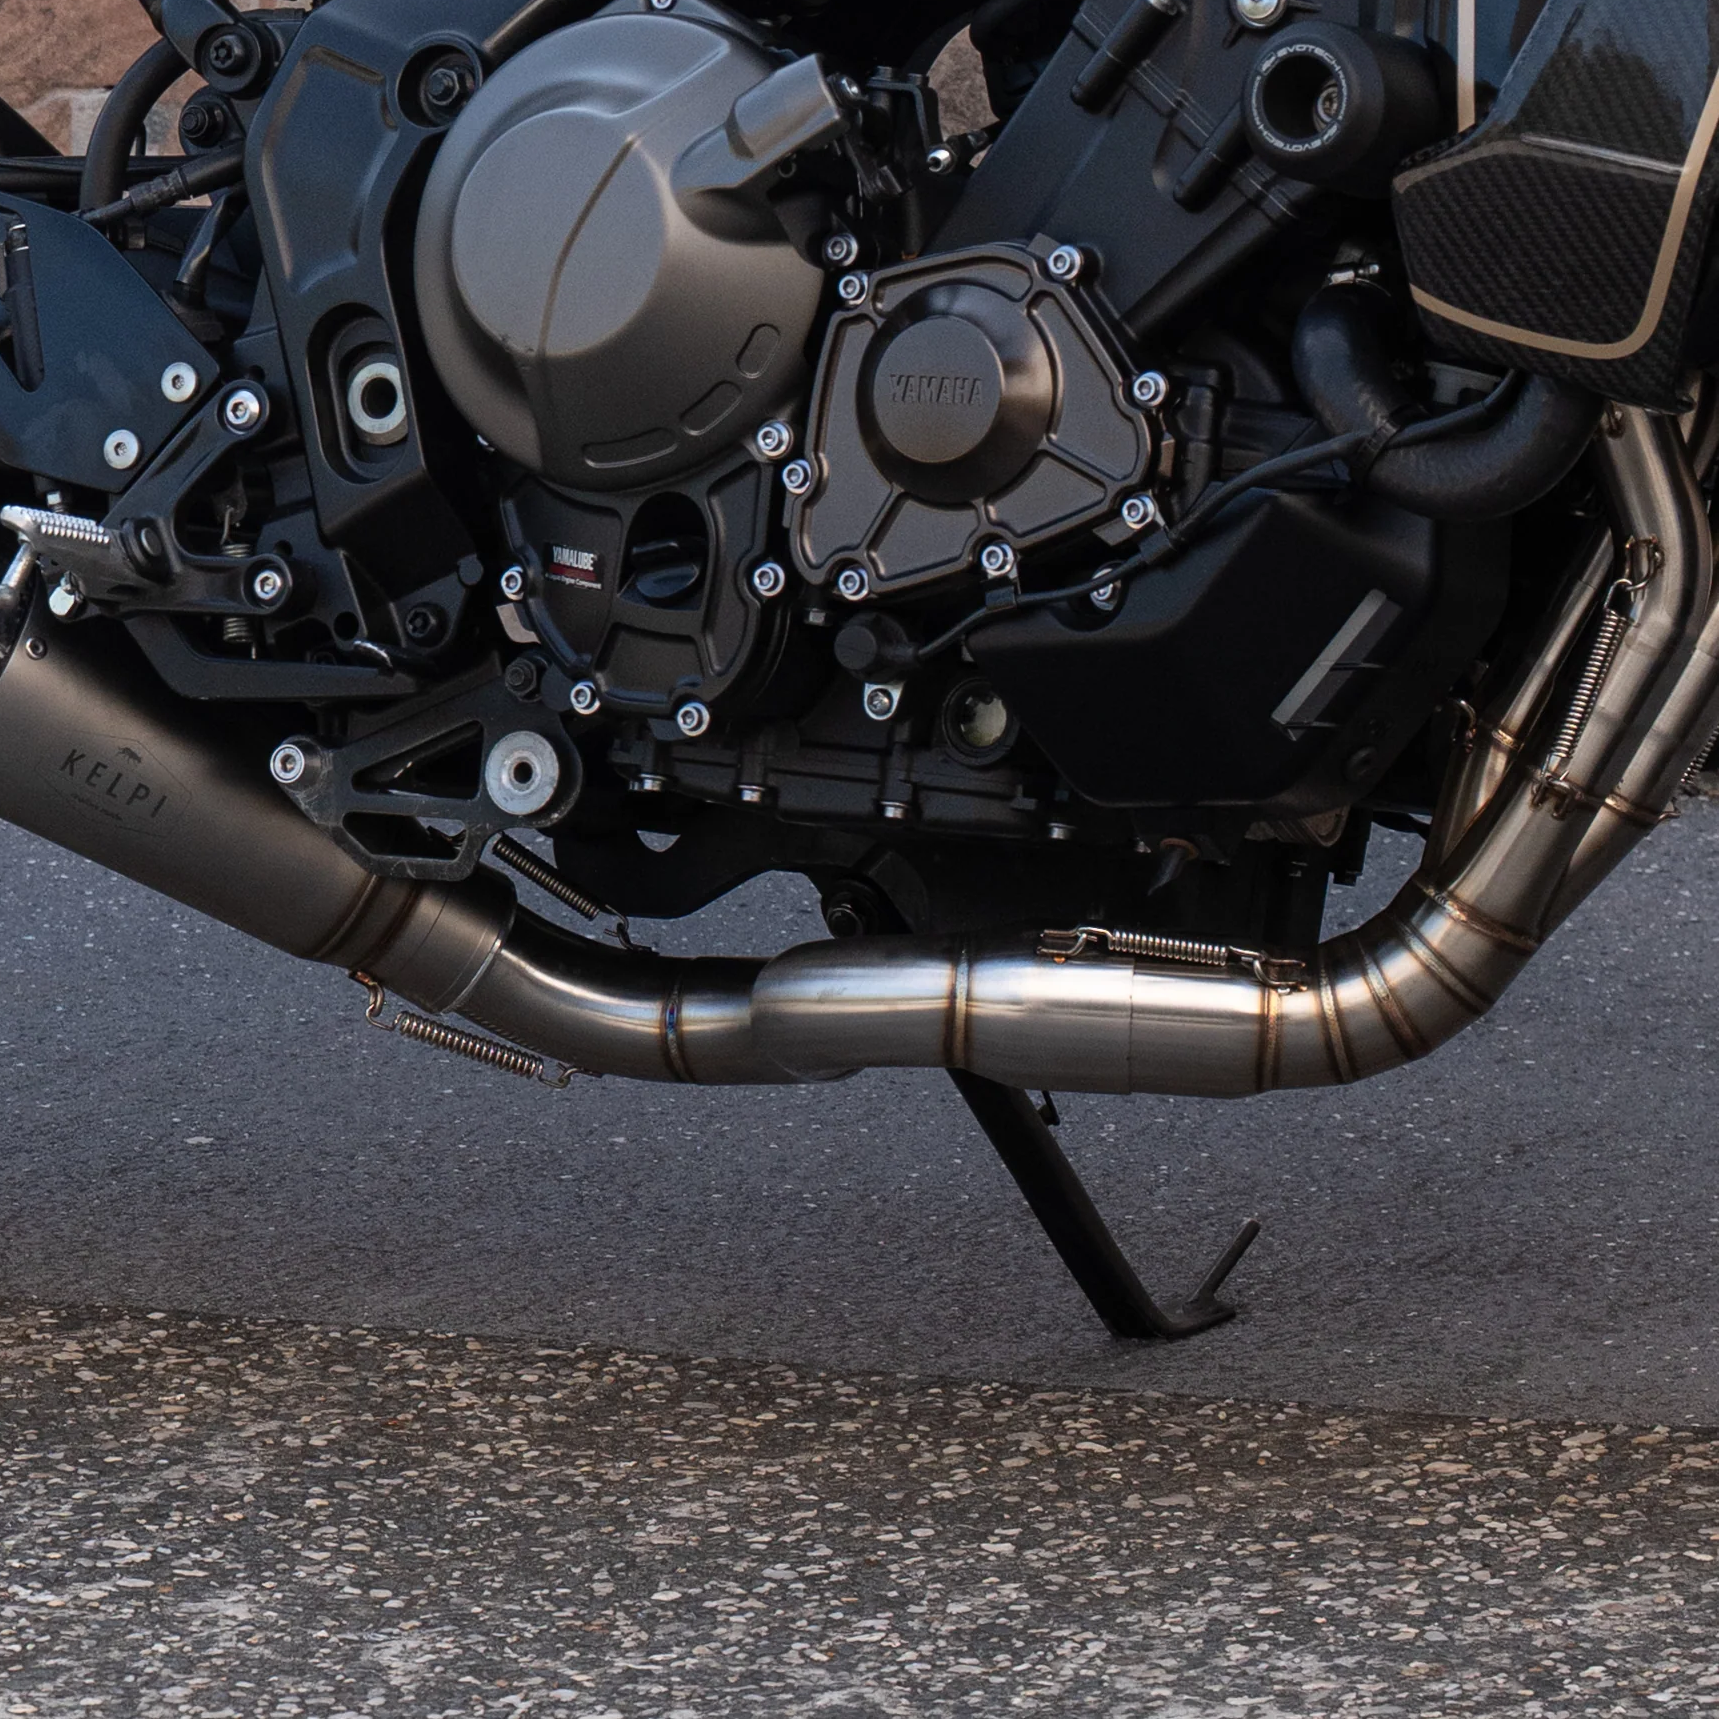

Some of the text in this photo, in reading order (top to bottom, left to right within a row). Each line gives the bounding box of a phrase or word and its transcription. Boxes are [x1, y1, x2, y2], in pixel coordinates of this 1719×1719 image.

[1276, 43, 1342, 72] EVOTECH
[888, 373, 985, 405] YAMAHA
[59, 748, 169, 819] KELPI
